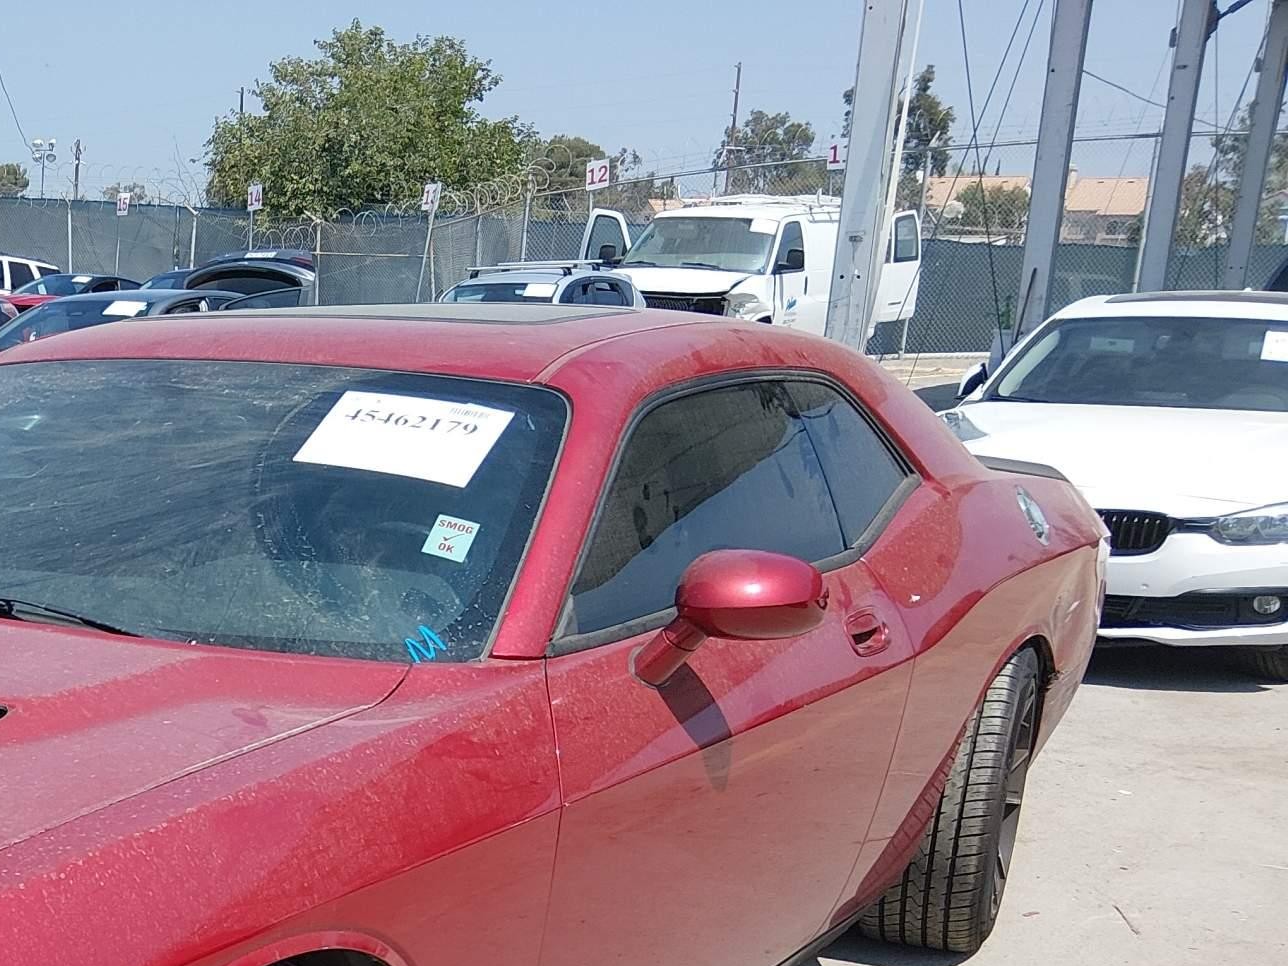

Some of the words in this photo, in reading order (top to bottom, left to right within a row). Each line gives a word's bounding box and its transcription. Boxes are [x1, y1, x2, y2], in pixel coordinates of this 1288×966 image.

[587, 165, 608, 186] 12
[118, 197, 128, 212] 15
[248, 189, 261, 207] 14
[344, 408, 479, 436] 45462179
[438, 519, 475, 535] SMOG
[438, 542, 455, 553] OK
